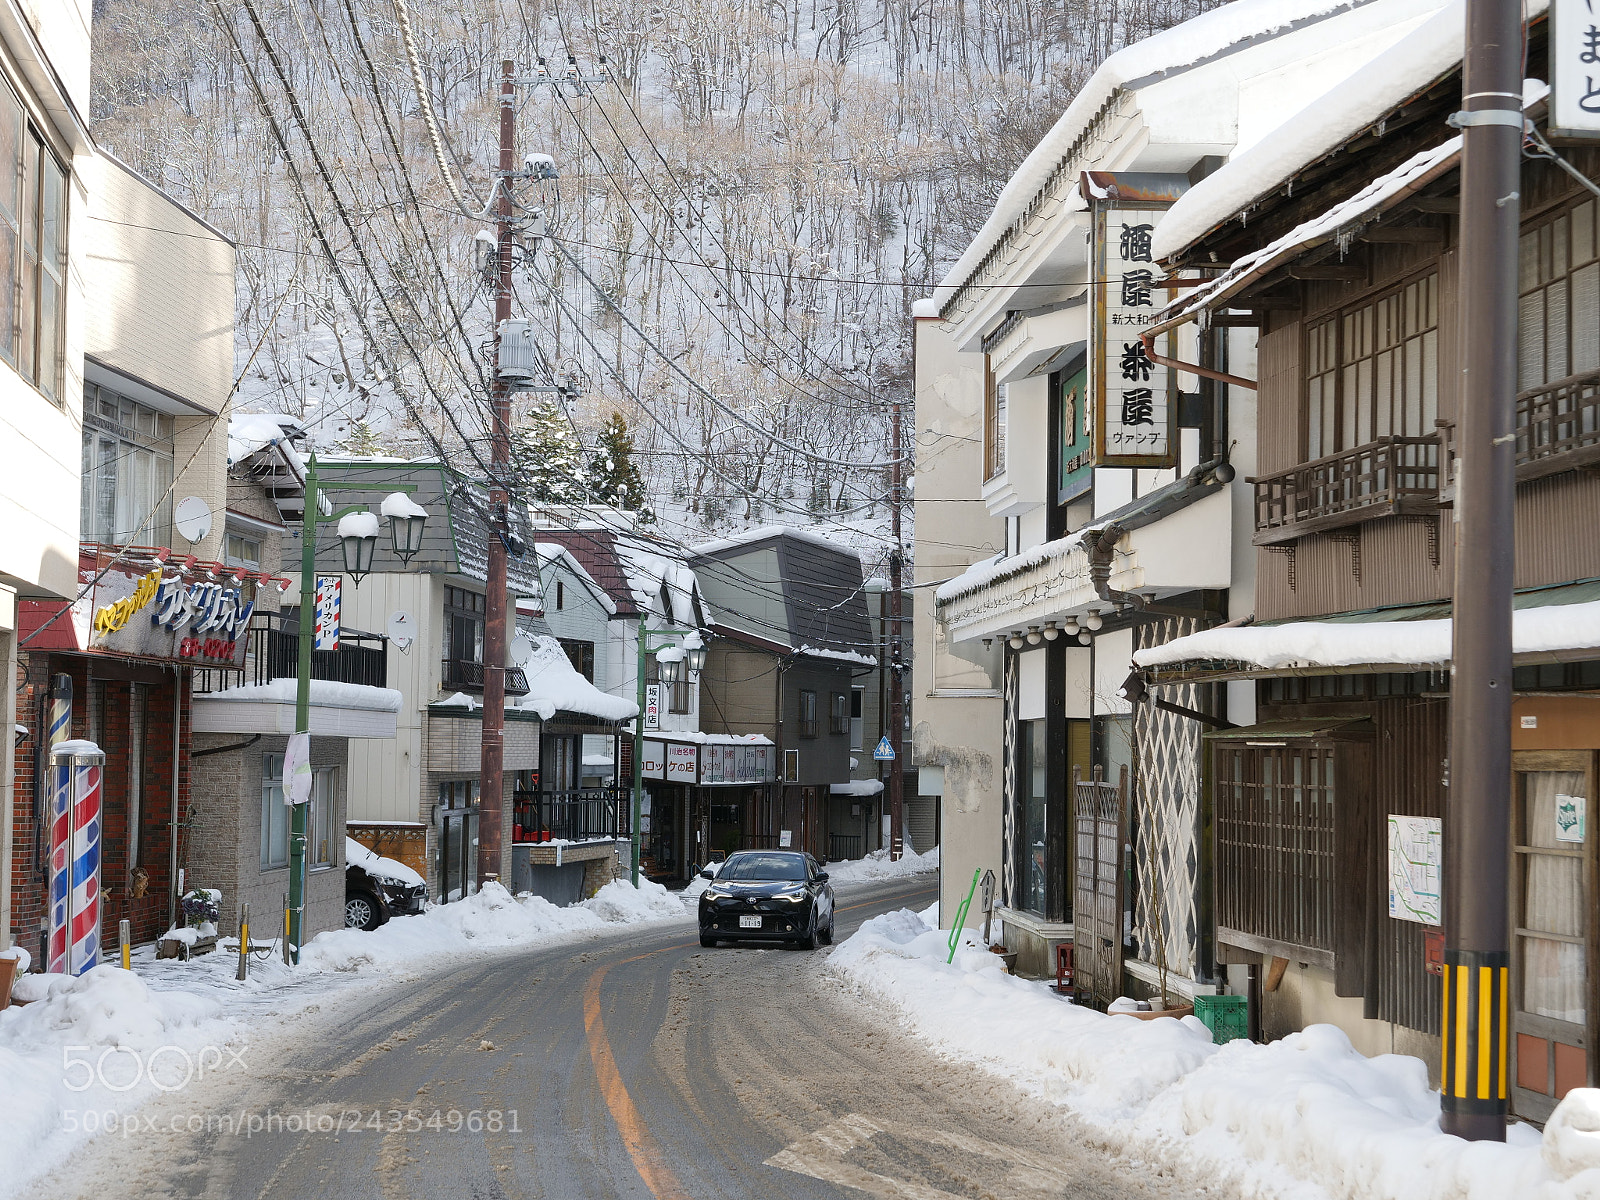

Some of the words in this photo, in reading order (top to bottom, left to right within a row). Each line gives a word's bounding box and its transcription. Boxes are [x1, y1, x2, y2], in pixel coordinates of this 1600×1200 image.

[1111, 313, 1155, 326] 新大和
[648, 687, 657, 724] 坂文肉店
